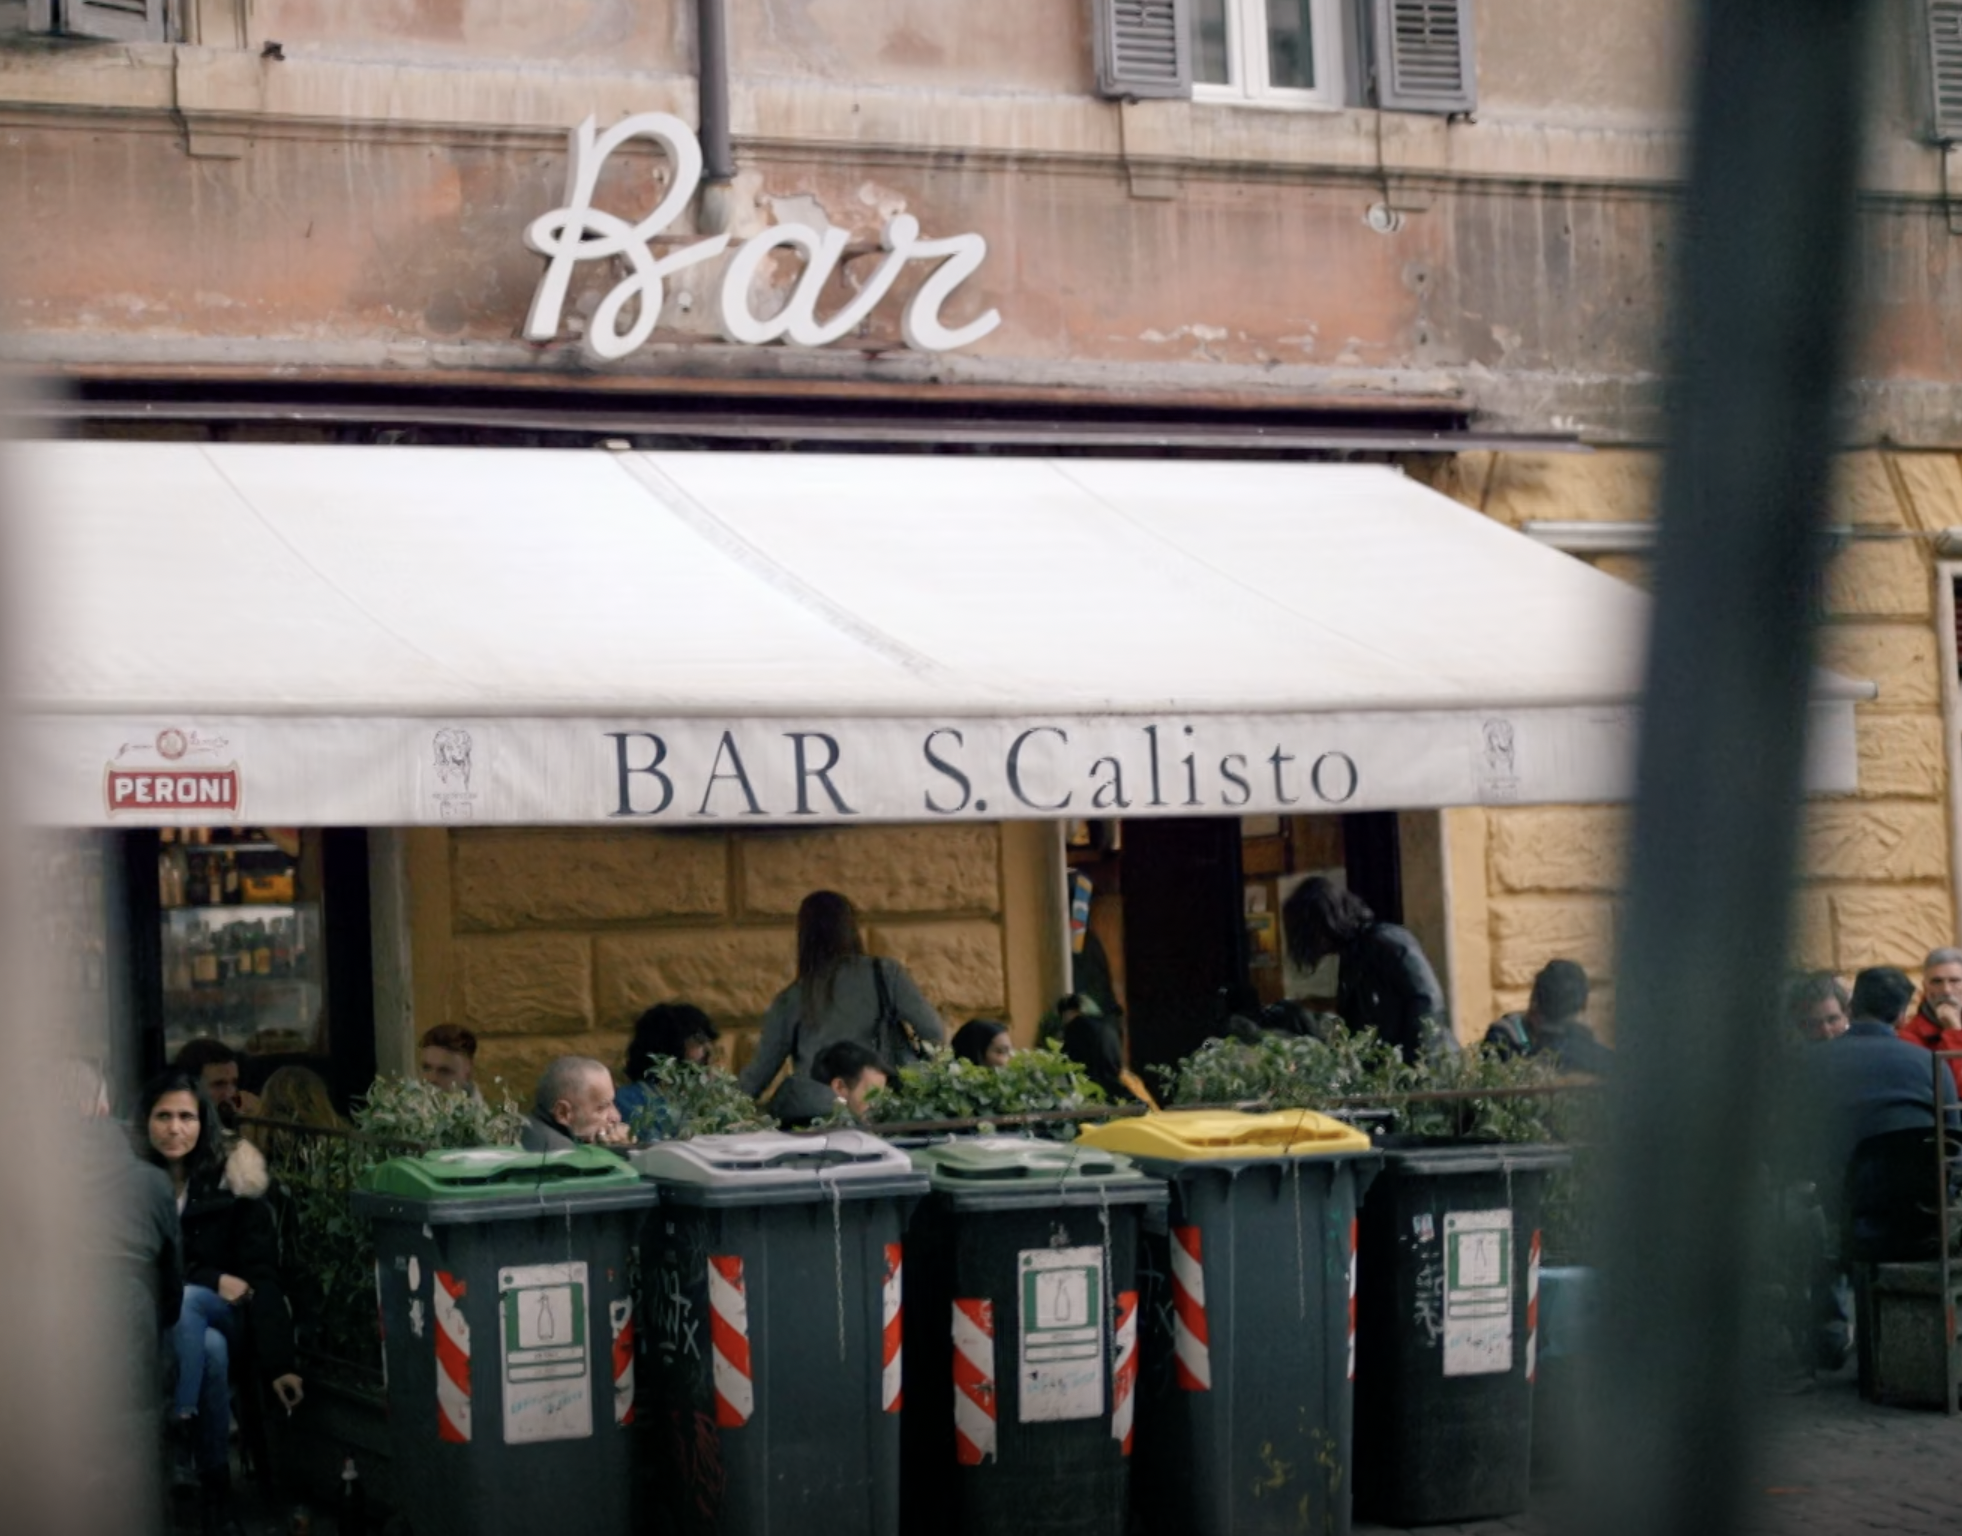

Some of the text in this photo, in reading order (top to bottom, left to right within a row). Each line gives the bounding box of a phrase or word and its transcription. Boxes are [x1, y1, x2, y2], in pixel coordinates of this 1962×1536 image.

[523, 112, 1000, 359] Bar
[114, 776, 231, 803] PERONI
[604, 730, 860, 817] BAR
